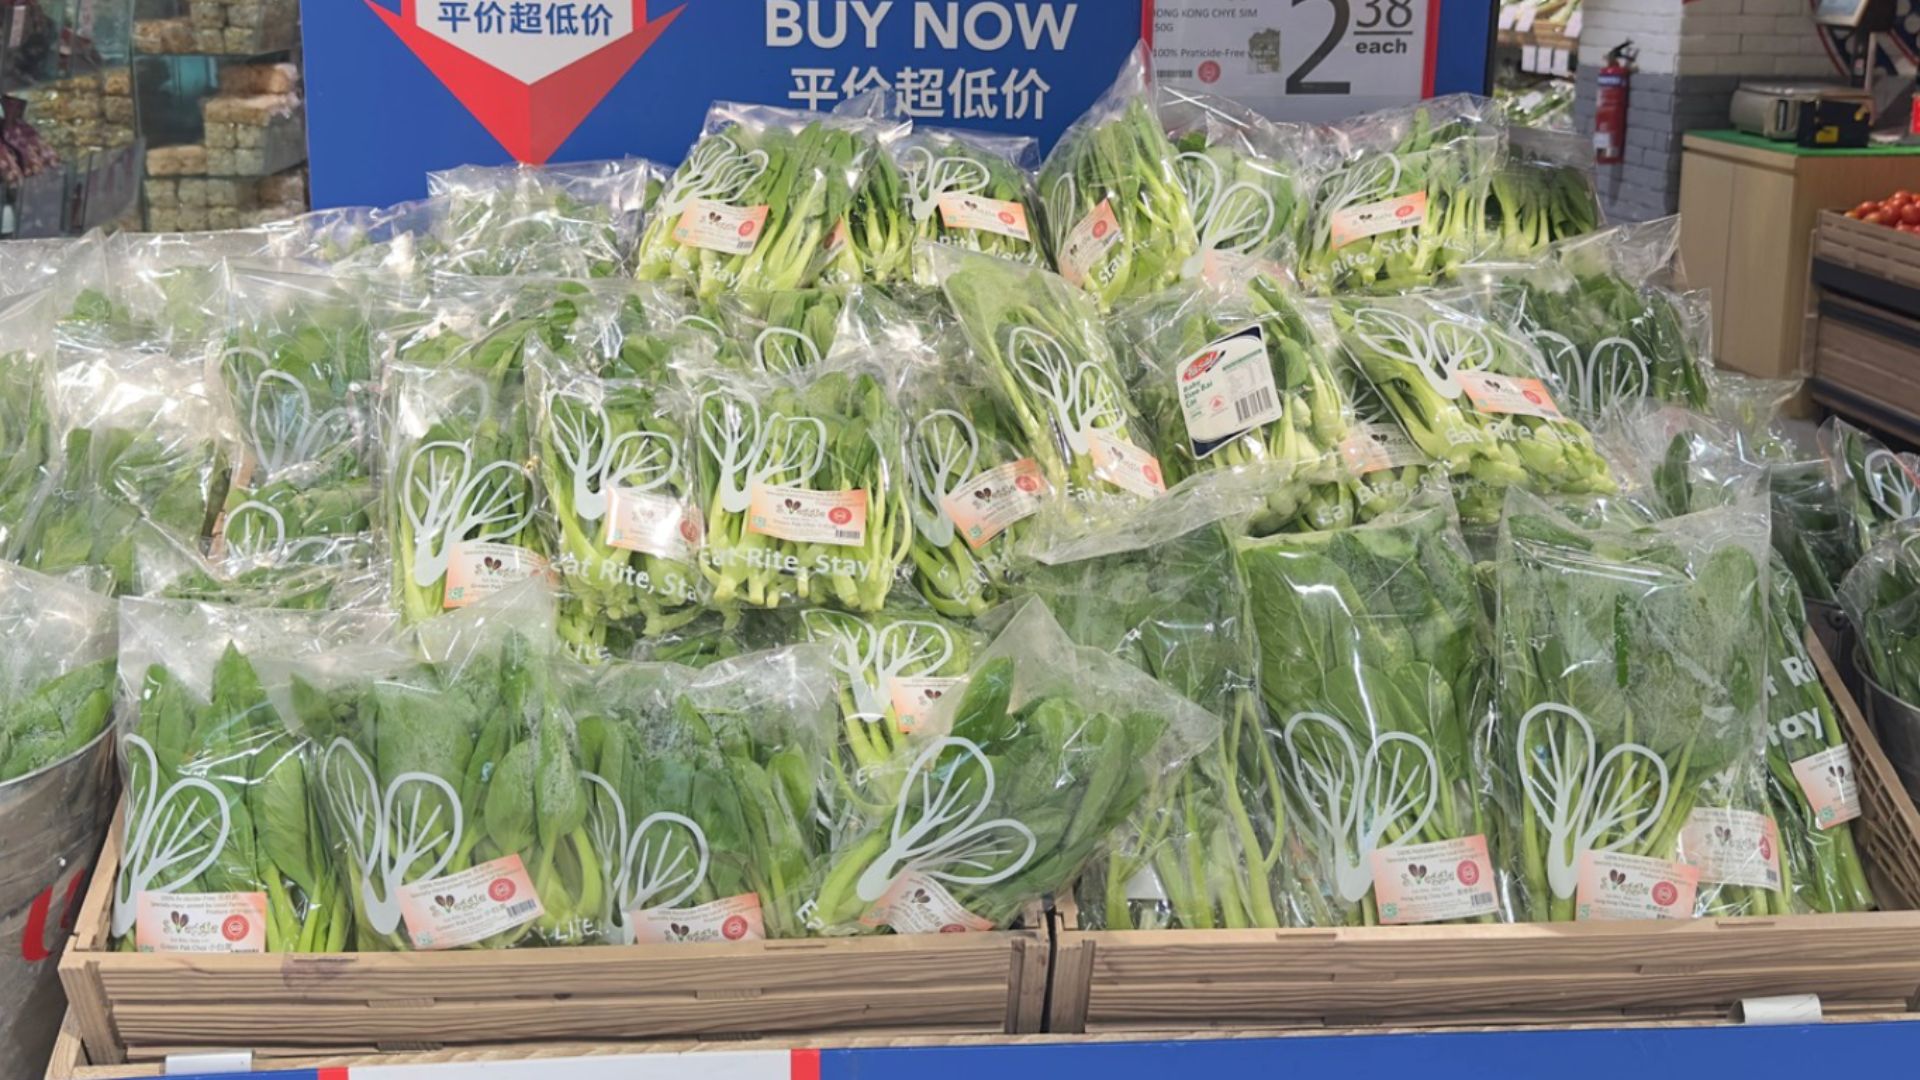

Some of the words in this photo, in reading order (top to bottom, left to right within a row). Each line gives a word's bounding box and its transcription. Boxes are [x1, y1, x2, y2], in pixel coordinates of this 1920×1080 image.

[437, 1, 613, 36] 平价超低价
[766, 0, 893, 49] BUY
[914, 1, 1078, 50] NOW
[1153, 23, 1174, 32] 50G
[1182, 8, 1210, 18] KONG
[1212, 8, 1237, 18] CHYE
[1239, 8, 1258, 18] SIM
[1355, 37, 1408, 54] each
[600, 559, 655, 595] Rite,
[747, 547, 807, 577] Rite,
[815, 554, 872, 582] Stay
[1767, 707, 1824, 747] tay
